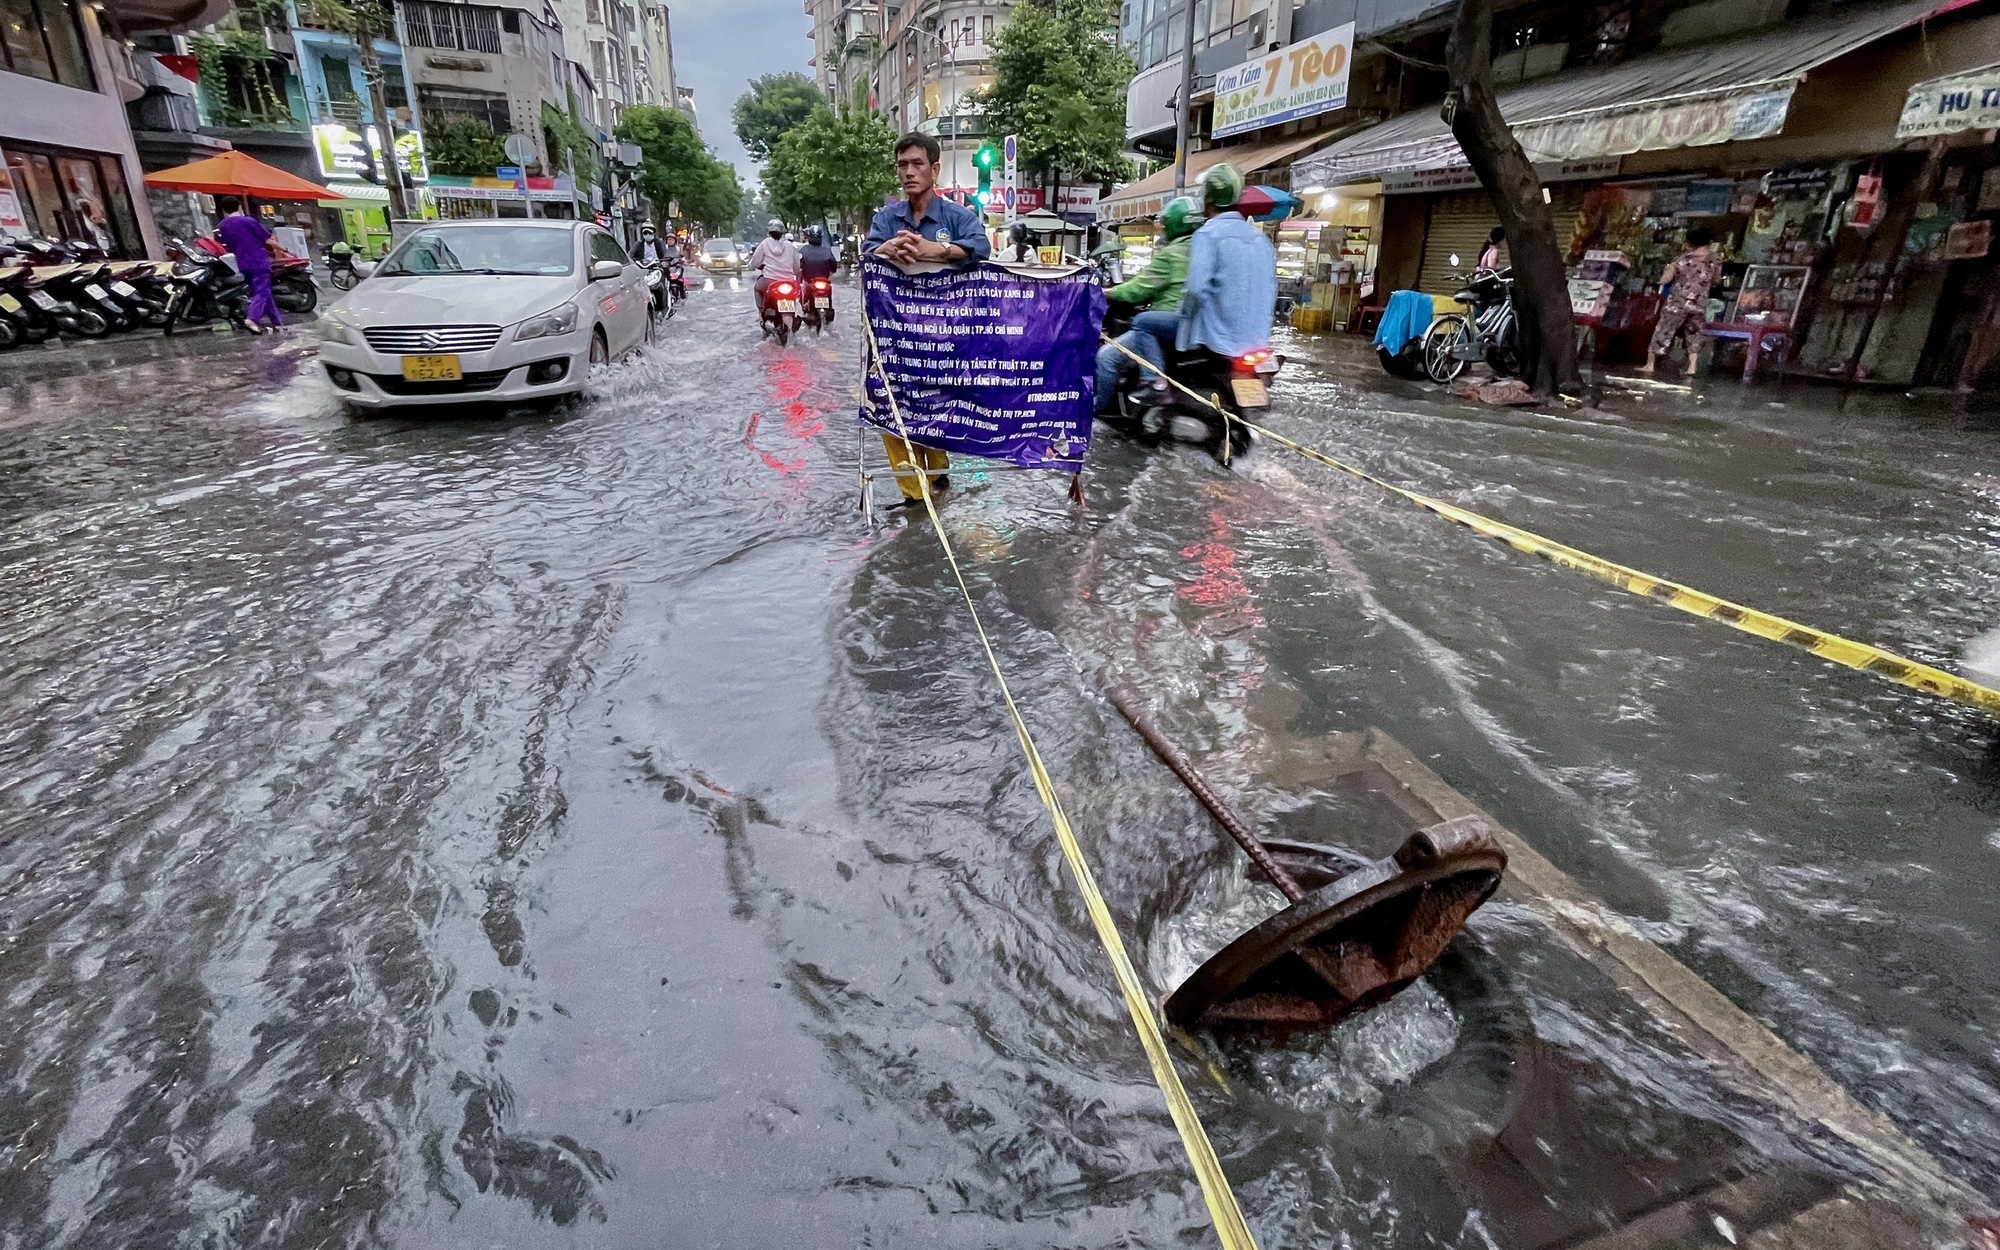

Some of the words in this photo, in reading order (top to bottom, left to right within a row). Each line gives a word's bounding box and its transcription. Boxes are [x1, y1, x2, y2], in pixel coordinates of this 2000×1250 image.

[1264, 56, 1283, 97] 7
[1289, 41, 1346, 89] Tèo
[1217, 75, 1238, 94] Cơm
[1003, 289, 1021, 298] XANH
[936, 307, 945, 317] XE
[903, 323, 923, 335] PHẠM
[939, 324, 952, 335] LÃO
[1006, 326, 1024, 335] MINH
[914, 340, 936, 352] THOÁT
